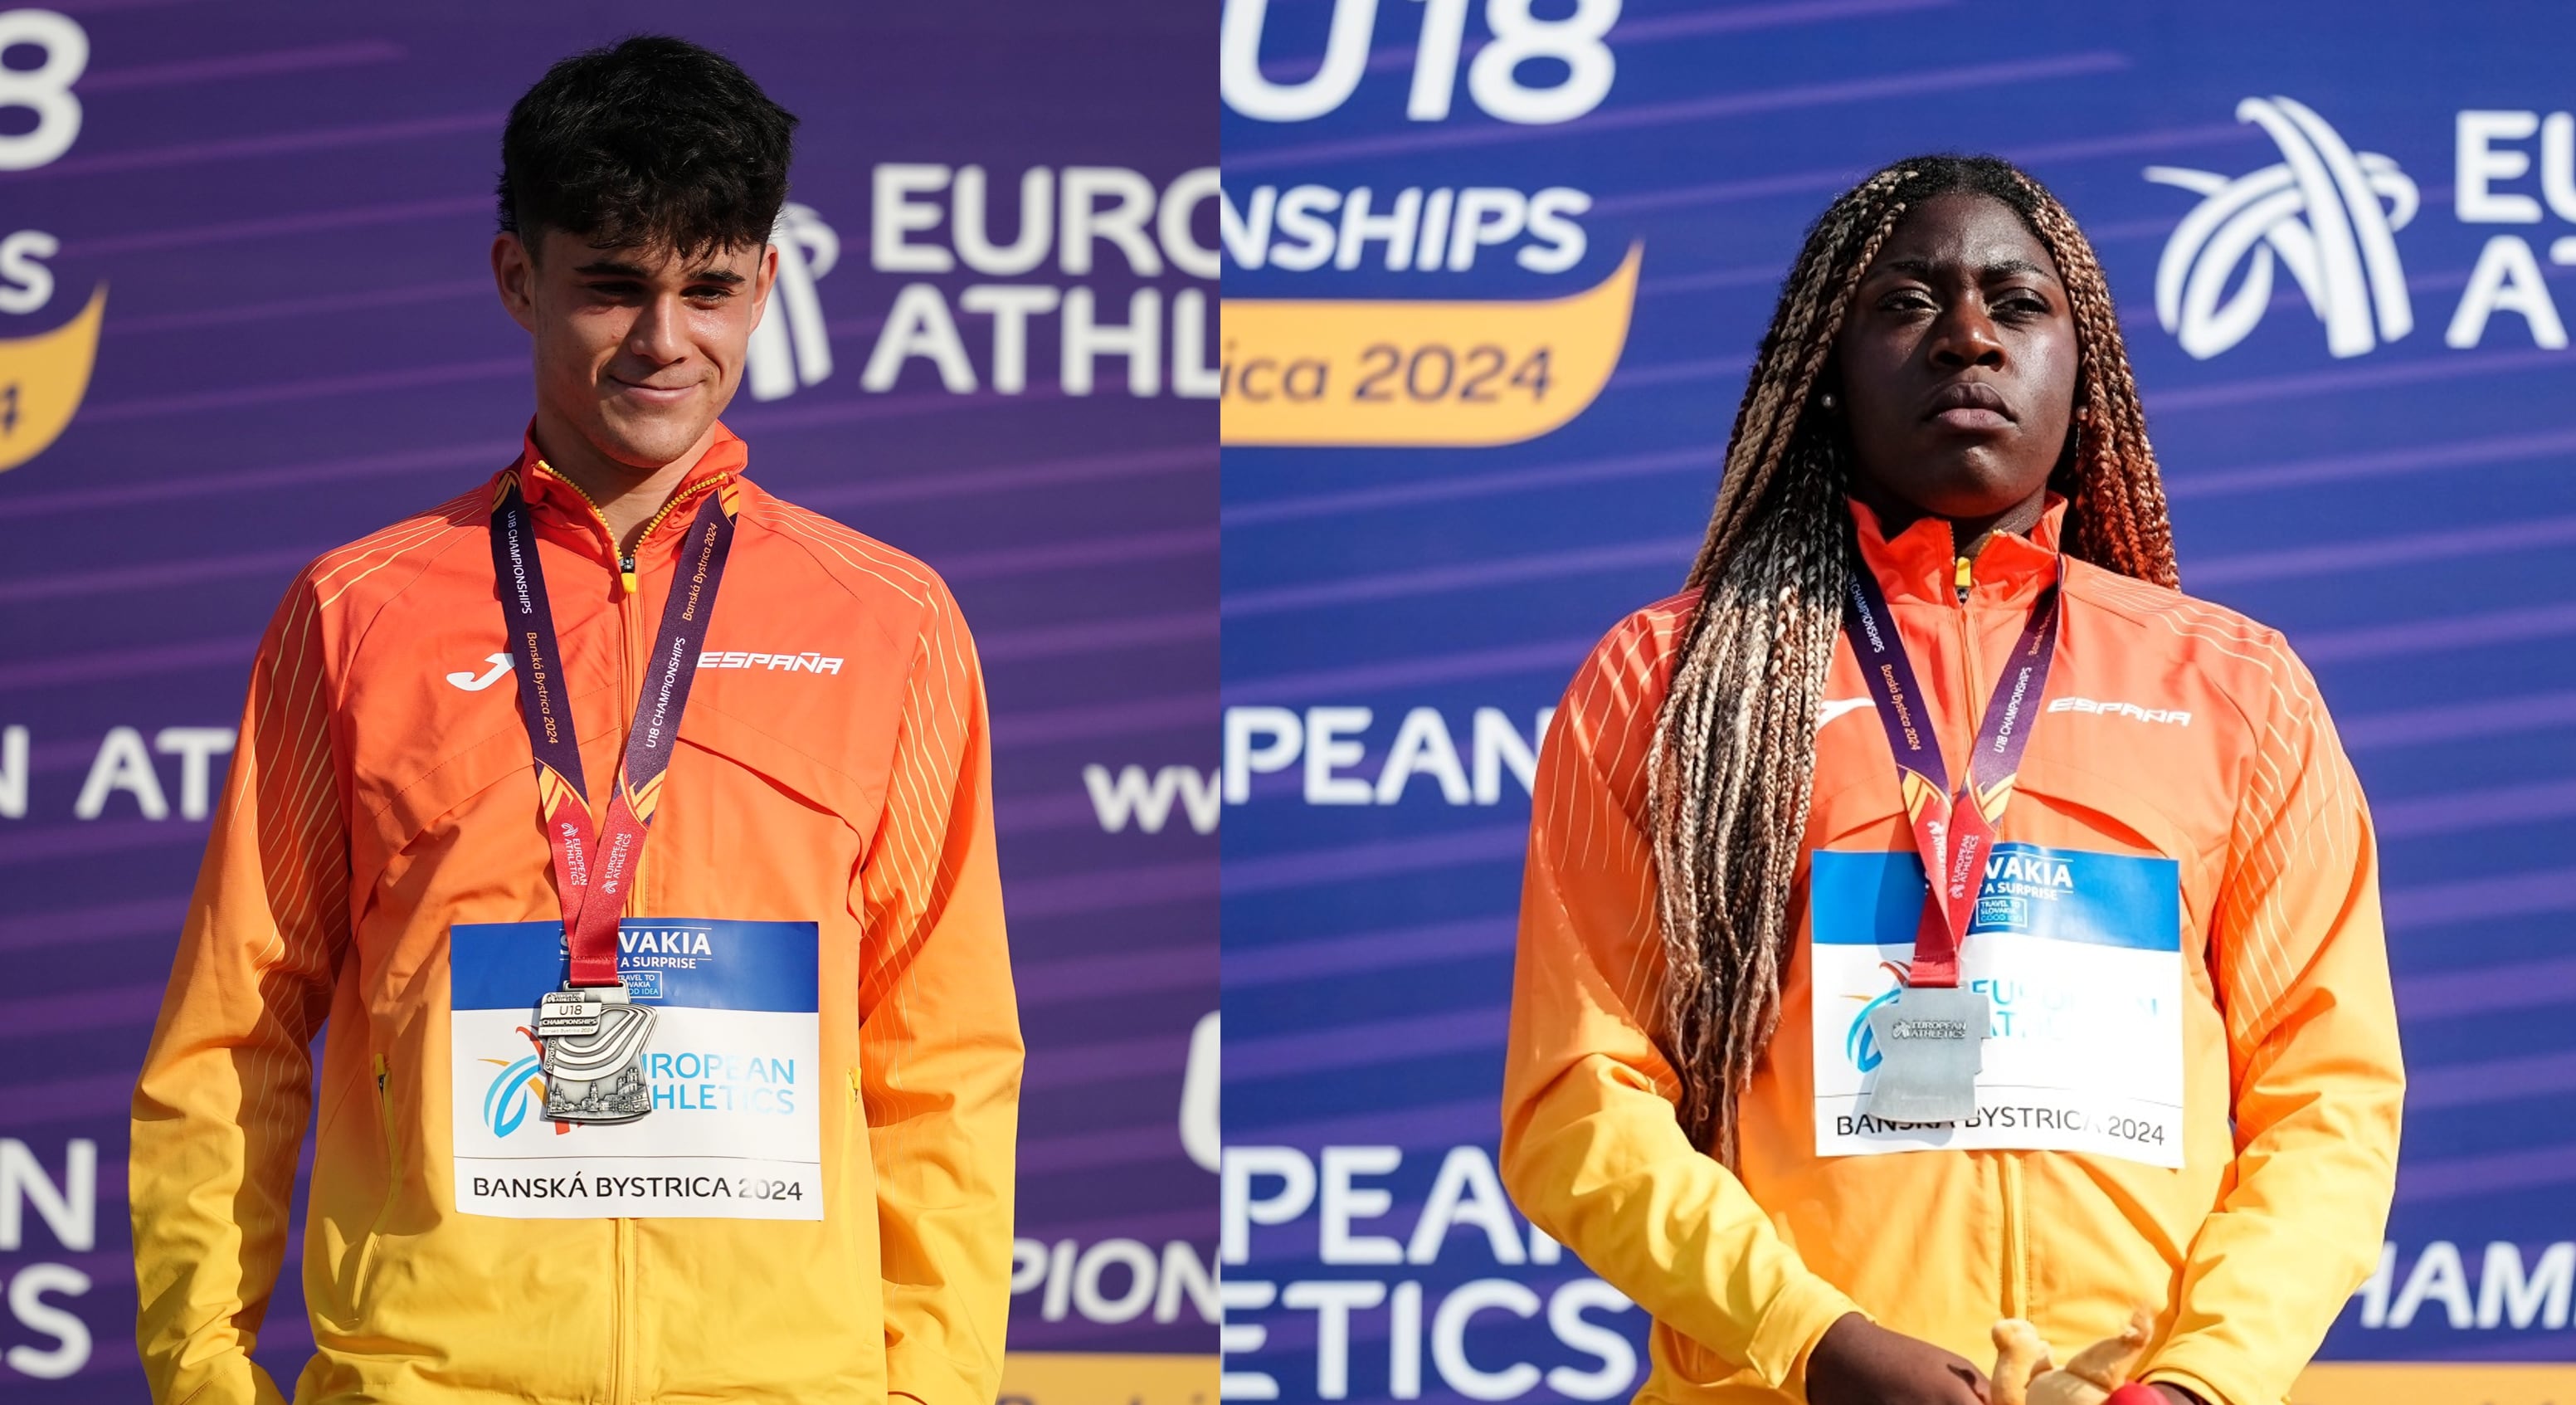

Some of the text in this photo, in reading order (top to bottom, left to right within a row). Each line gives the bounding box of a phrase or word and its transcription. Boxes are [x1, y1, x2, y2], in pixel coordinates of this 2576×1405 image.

[1220, 0, 1624, 124] U18
[870, 163, 1220, 279] EURO
[1220, 184, 1593, 274] NSHIPS
[0, 230, 60, 315] S
[2444, 234, 2576, 350] A
[860, 283, 1220, 398] ATHL
[1353, 342, 1555, 404] 2024
[507, 510, 558, 744] U18 CHAMPIONSHIPS Banská Bystrica 2024
[645, 522, 718, 749] U18 CHAMPIONSHIPS Banská Bystrica 2024
[697, 651, 844, 676] ESPAÑA
[1849, 583, 1885, 653] CHAMPIONSHIPS
[1904, 727, 1921, 750] 2024
[1999, 666, 2033, 737] CHAMPIONSHIPS
[74, 725, 237, 822] AT
[1223, 706, 1558, 806] PEAN
[1993, 734, 2009, 754] U18
[564, 838, 580, 885] ATHLETICS
[572, 838, 588, 885] EUROPEAN
[605, 833, 625, 879] EUROPEAN
[613, 833, 632, 879] ATHLETICS
[1985, 882, 2058, 901] A SURPRISE
[621, 957, 697, 969] A SURPRISE
[559, 1004, 582, 1016] U18
[1910, 1028, 1965, 1039] ATHLETICS
[1911, 1019, 1966, 1029] EUROPEAN
[546, 1038, 557, 1070] Slovakia
[648, 1084, 795, 1115] HLETICS
[1965, 1106, 2101, 1134] BYSTRICA
[2108, 1116, 2165, 1145] 2024
[0, 1138, 97, 1252] N
[474, 1171, 803, 1202] BANSKÁ BYSTRICA 2024
[1220, 1145, 1563, 1265] PEA
[1220, 1277, 1640, 1401] ETICS
